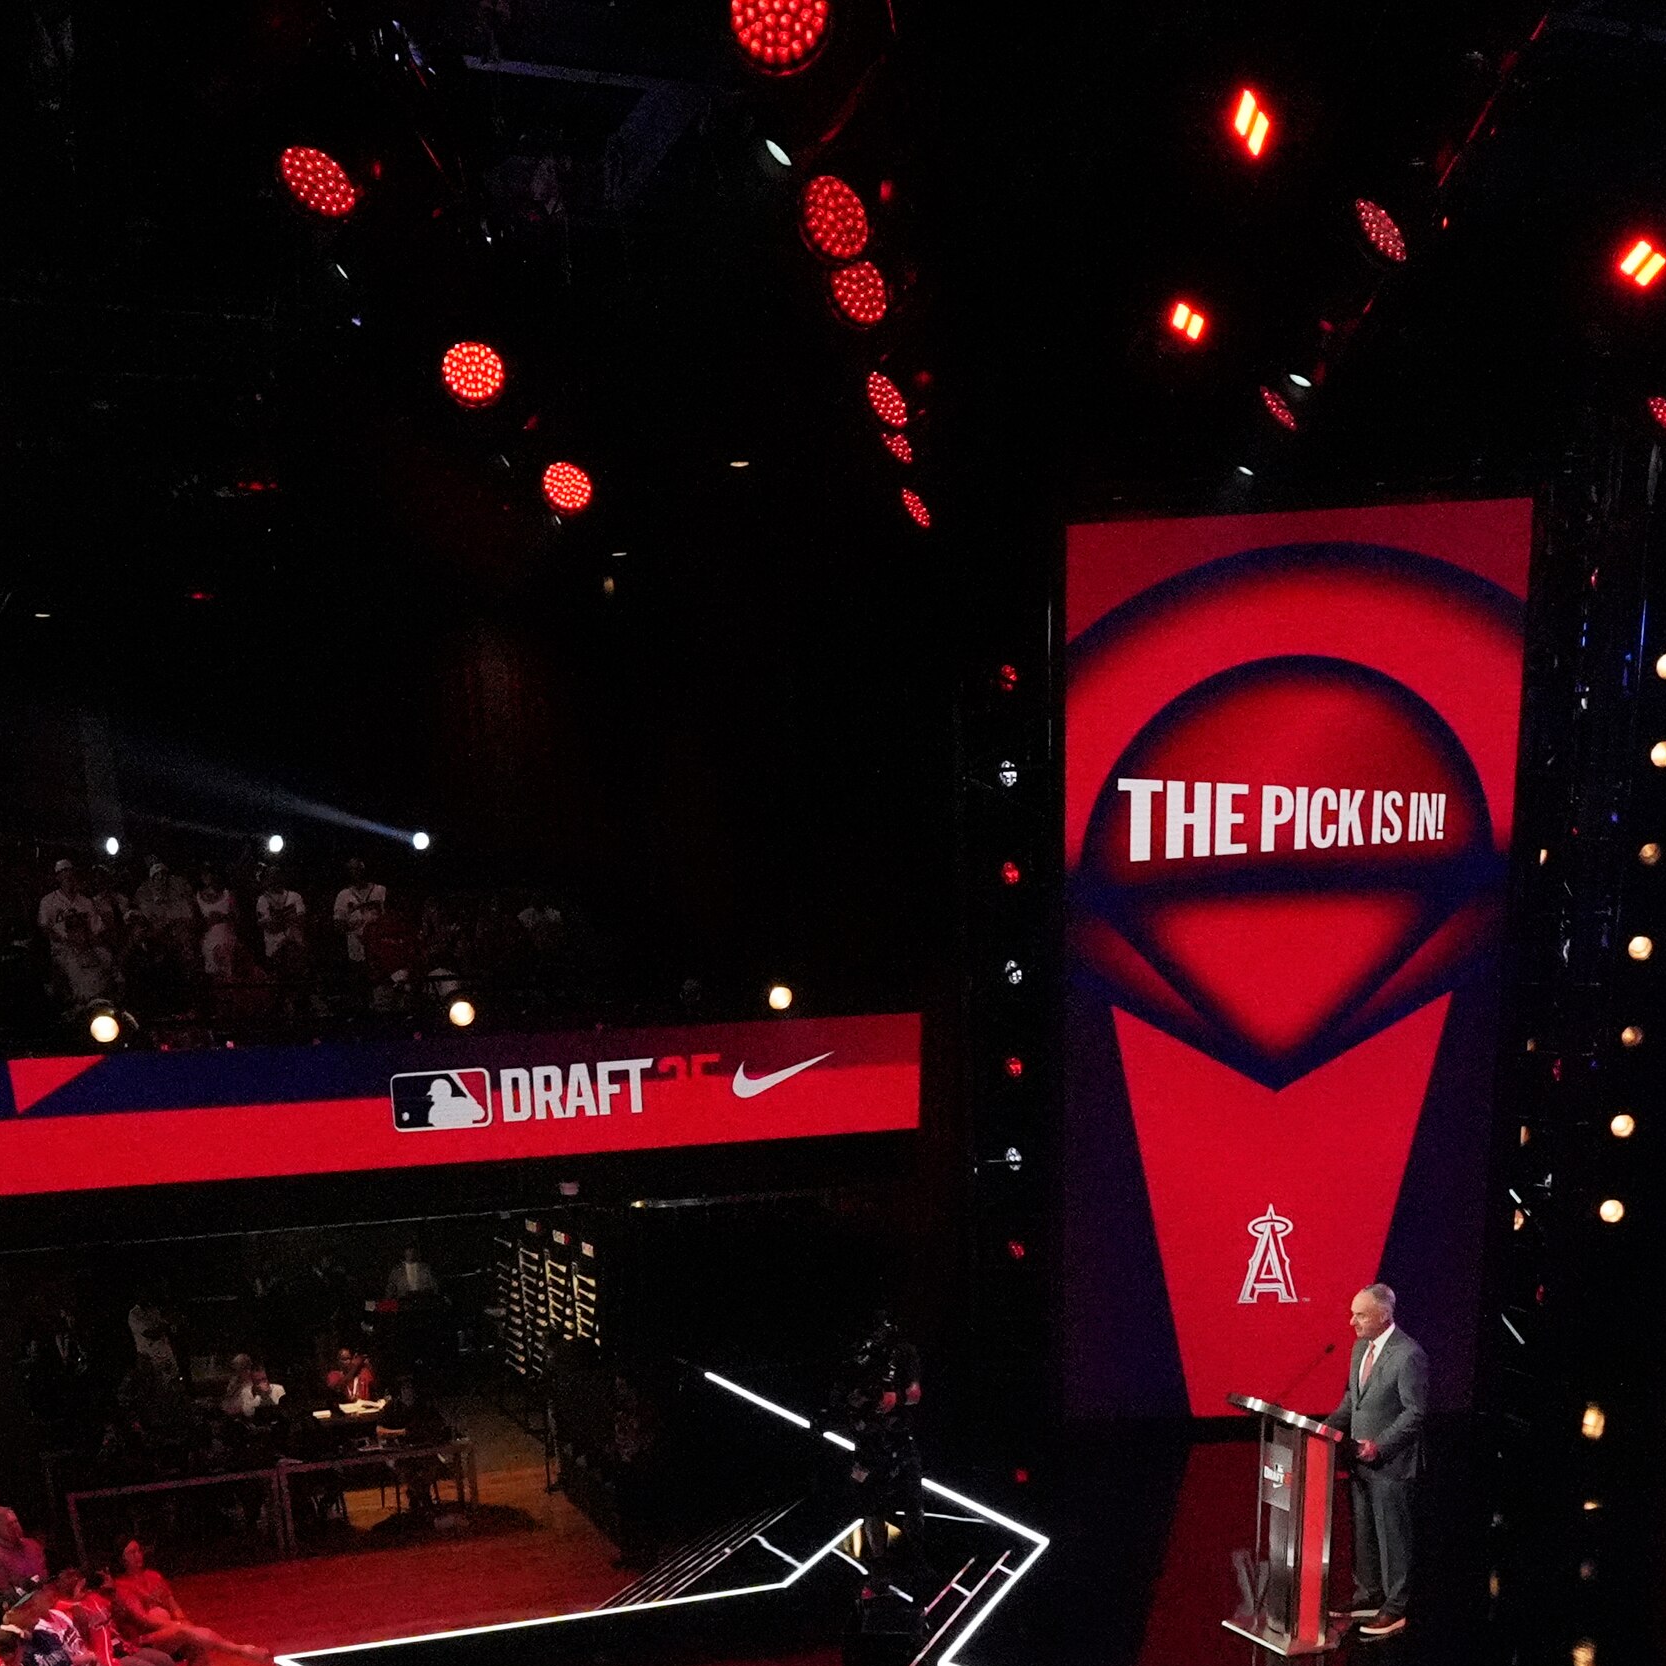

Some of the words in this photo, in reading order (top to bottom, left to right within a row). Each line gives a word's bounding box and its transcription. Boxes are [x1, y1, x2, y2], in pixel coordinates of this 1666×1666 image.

[1117, 777, 1250, 862] THE
[1260, 784, 1366, 853] PICK
[1371, 790, 1404, 845] IS
[1408, 791, 1448, 842] IN!
[499, 1057, 654, 1123] DRAFT
